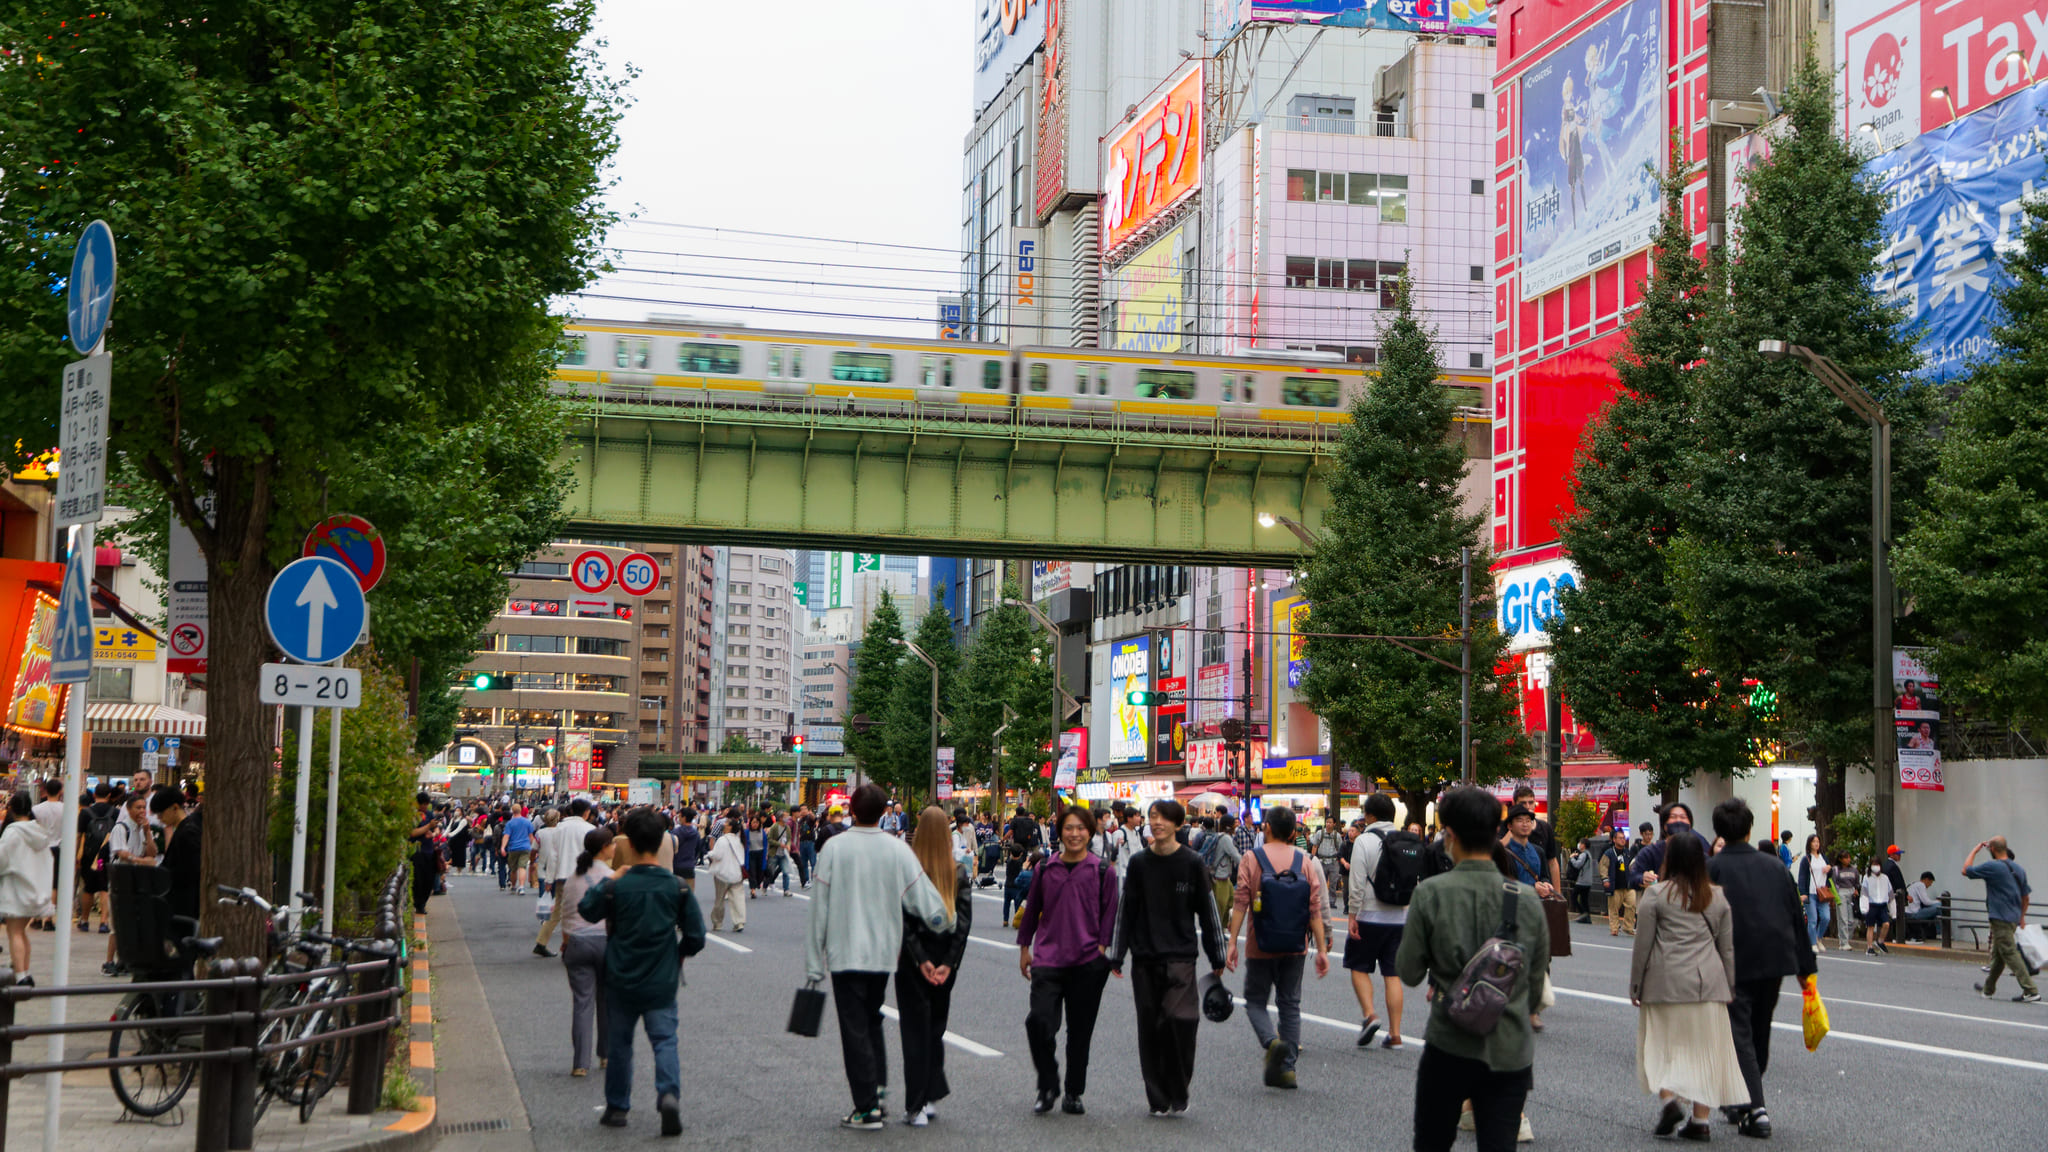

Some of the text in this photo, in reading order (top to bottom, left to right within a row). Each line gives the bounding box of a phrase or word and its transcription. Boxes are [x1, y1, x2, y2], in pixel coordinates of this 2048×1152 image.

[1105, 94, 1193, 230] オノデン
[65, 466, 97, 494] 13-17
[627, 565, 650, 584] 50
[1112, 650, 1148, 680] ONODEN
[275, 674, 348, 700] 8-20
